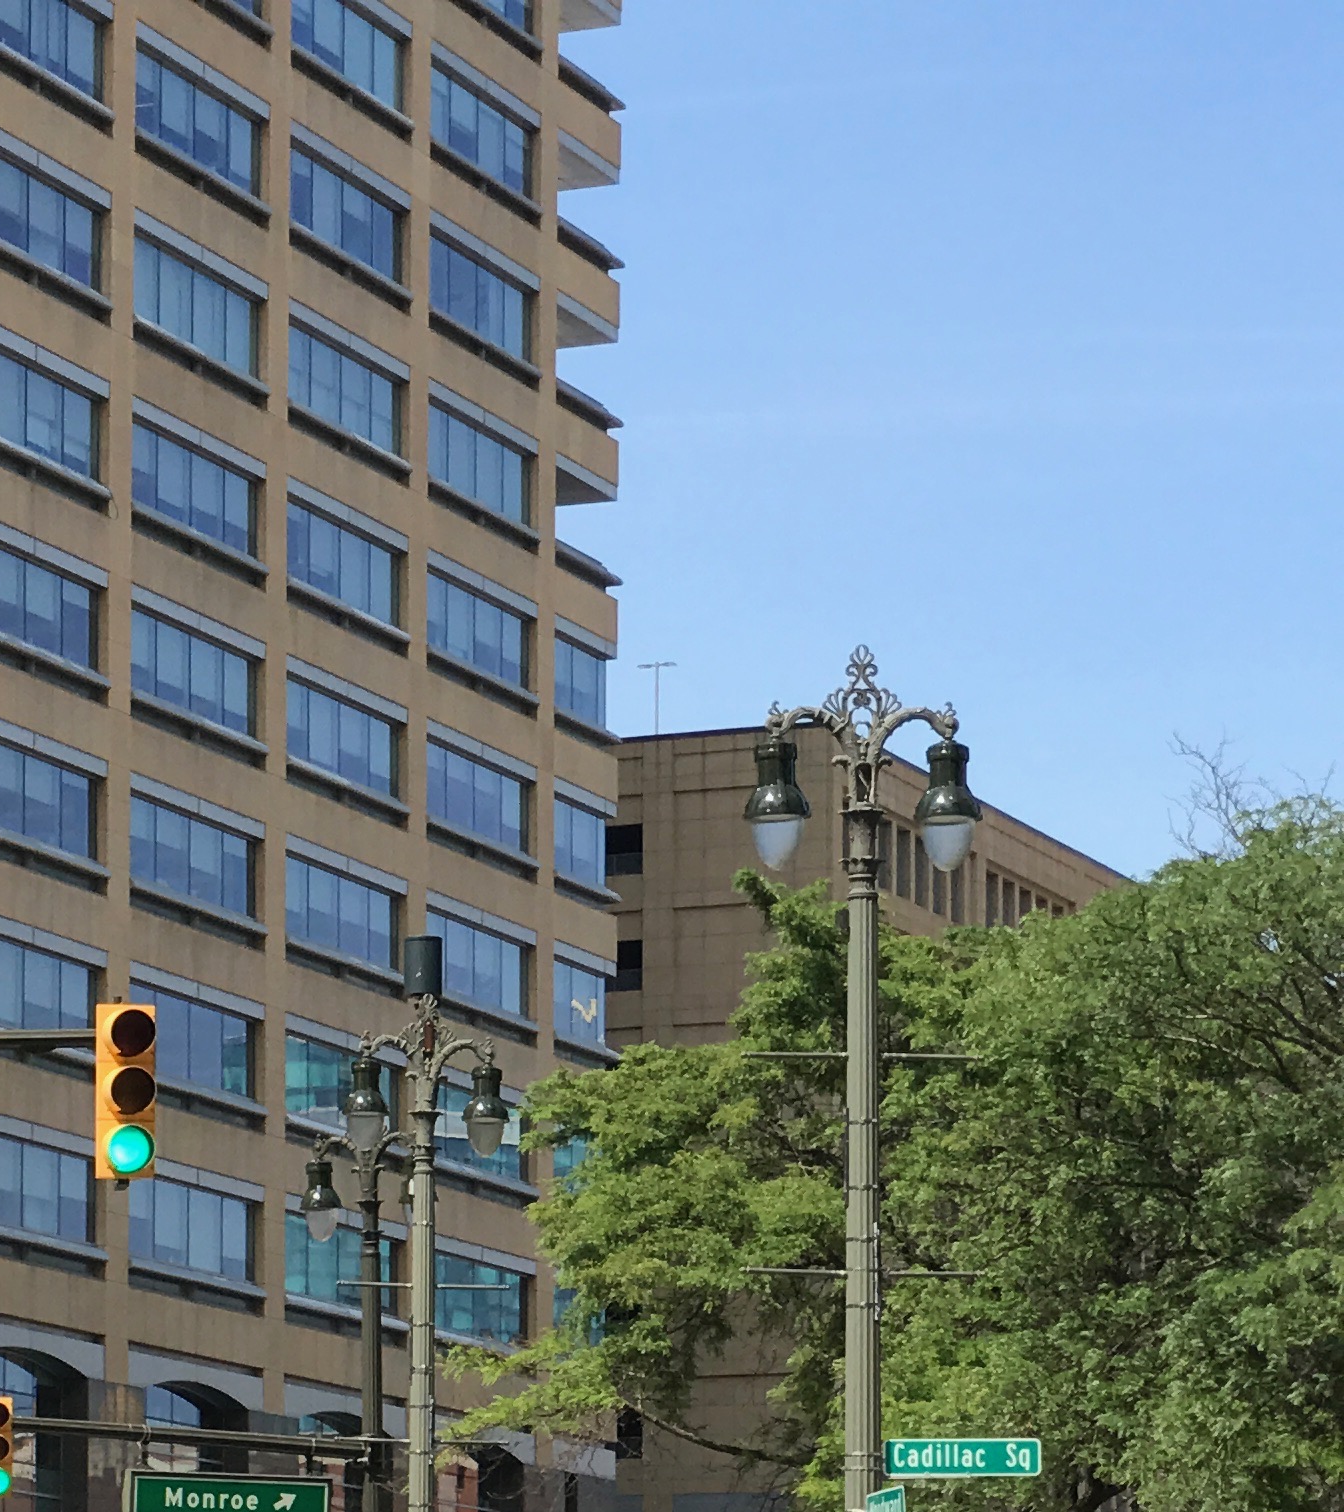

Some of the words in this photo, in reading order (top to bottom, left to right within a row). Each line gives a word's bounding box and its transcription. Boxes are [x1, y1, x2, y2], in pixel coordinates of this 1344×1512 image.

[893, 1443, 986, 1468] Cadillac
[1005, 1443, 1031, 1471] Sq
[163, 1486, 259, 1511] Monroe
